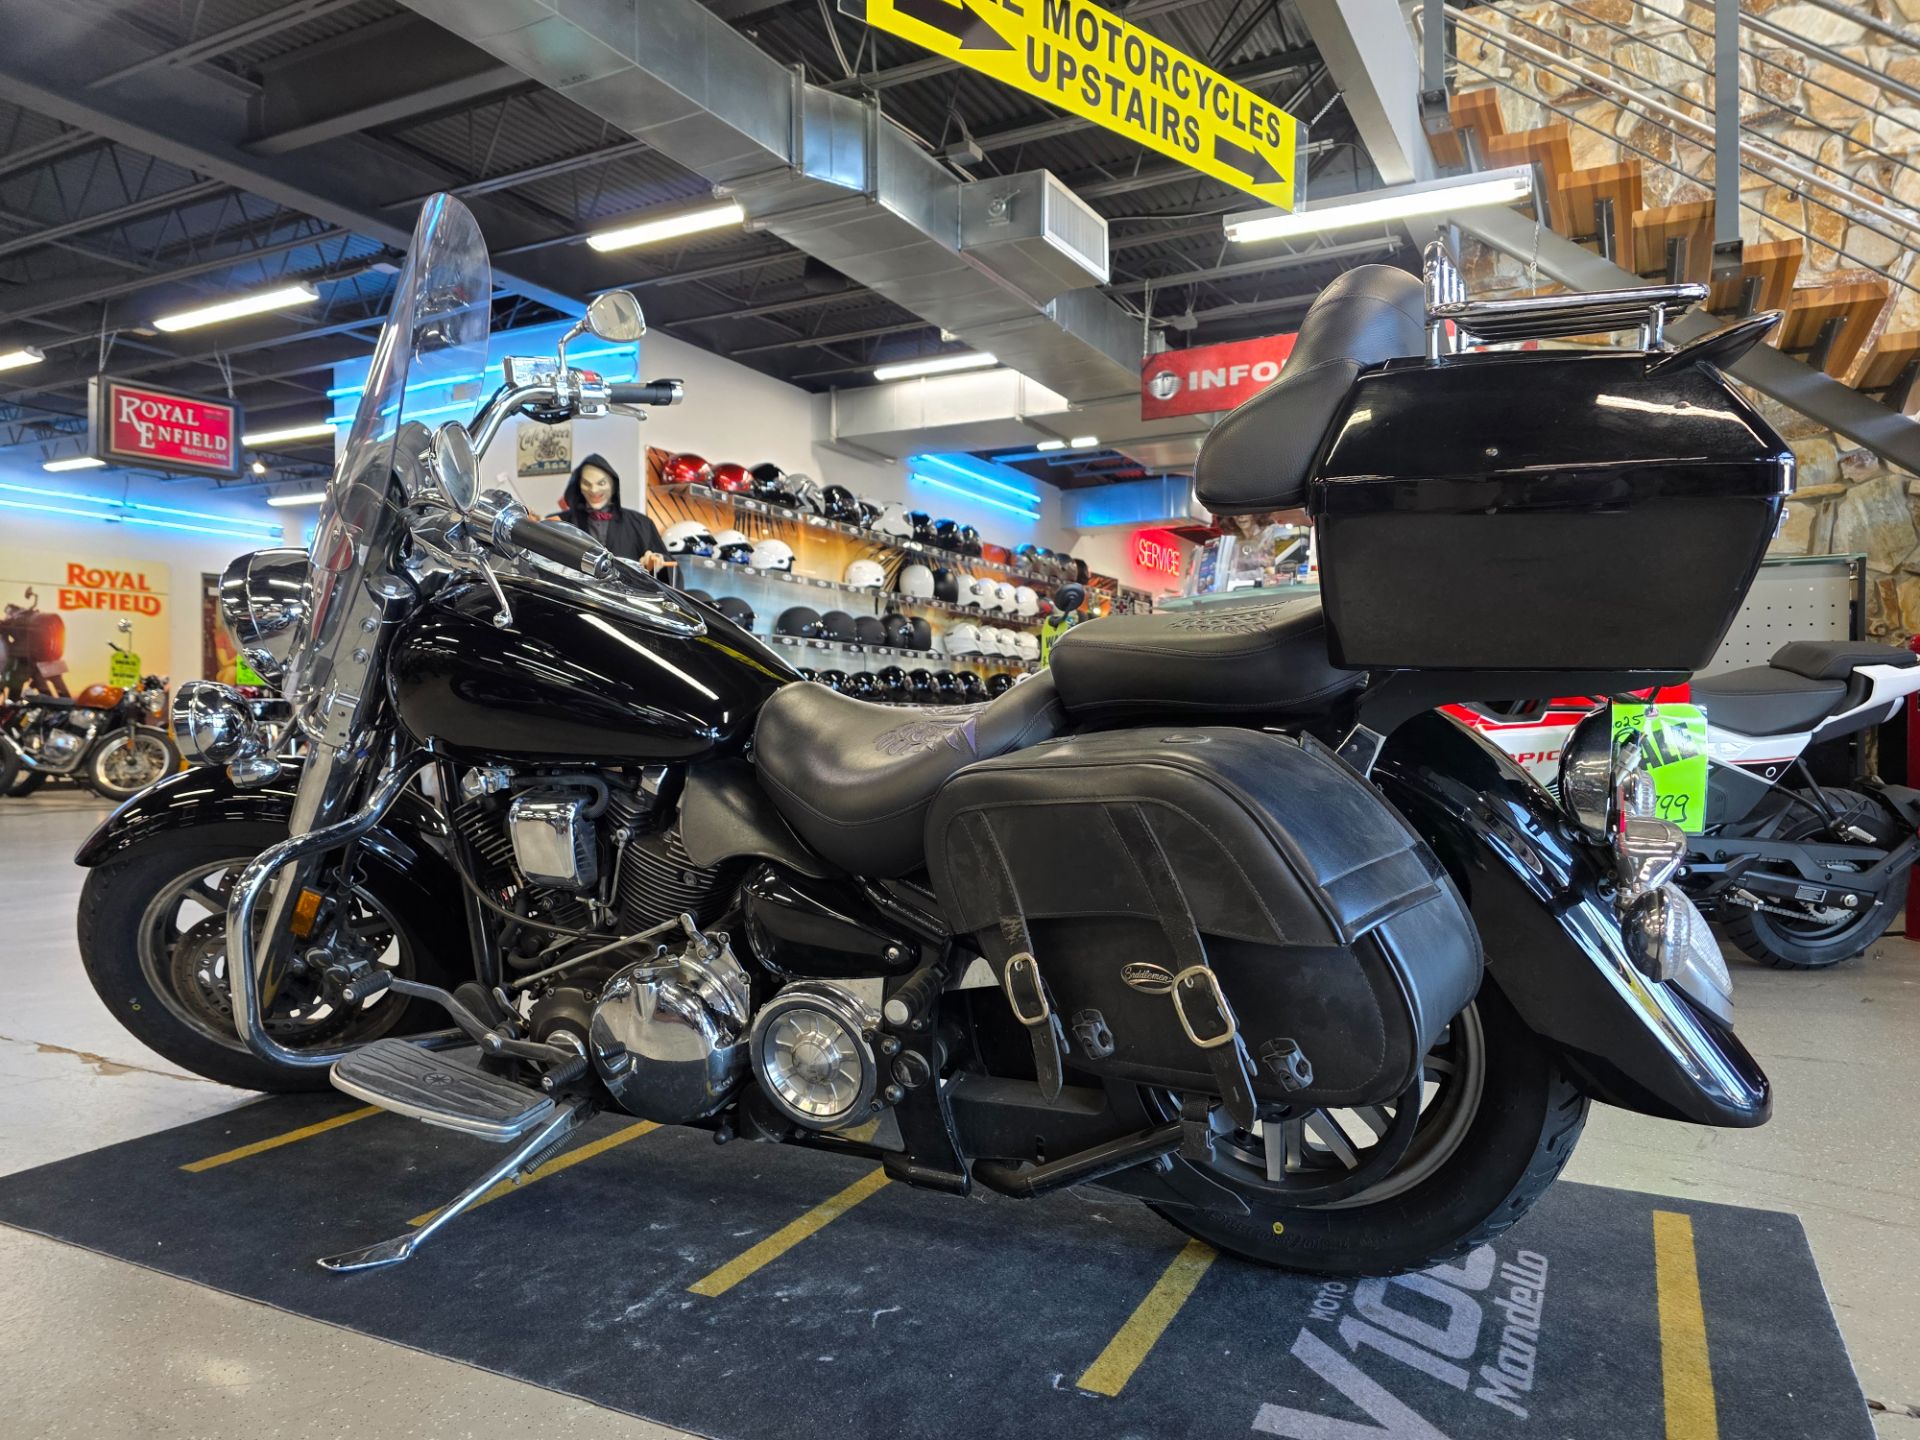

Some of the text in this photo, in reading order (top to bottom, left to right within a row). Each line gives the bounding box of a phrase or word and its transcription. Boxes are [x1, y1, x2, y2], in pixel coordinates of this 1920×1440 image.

[1042, 0, 1281, 148] MOTORCYCLES
[1027, 33, 1200, 154] UPSTAIRS
[1189, 358, 1287, 391] INFO
[118, 395, 200, 432] ROYAL
[138, 421, 227, 450] ENFIELD
[1138, 538, 1181, 577] SERVICE
[67, 562, 151, 592] ROYAL
[58, 589, 162, 617] ENFIELD
[1307, 1280, 1348, 1322] MOTO
[1474, 1250, 1549, 1421] Mandello
